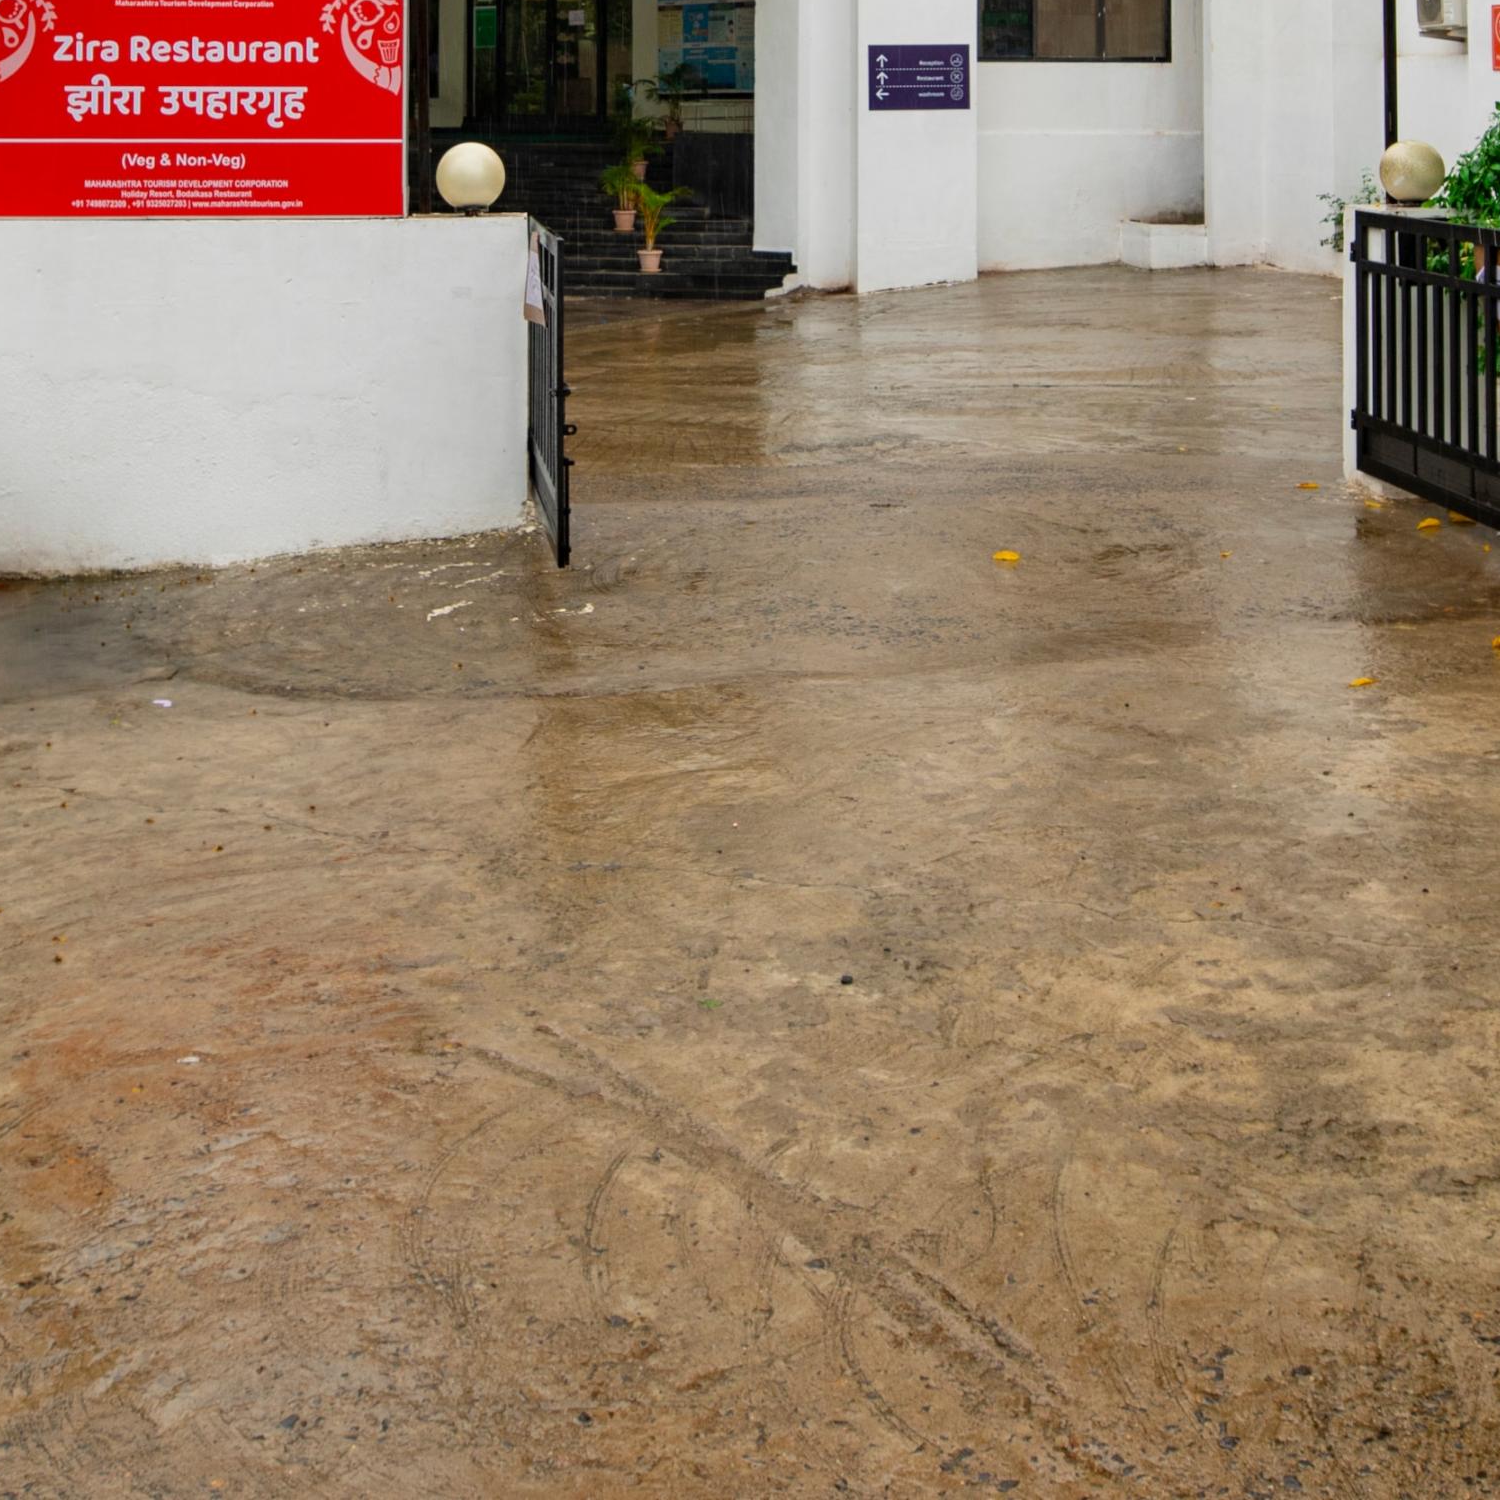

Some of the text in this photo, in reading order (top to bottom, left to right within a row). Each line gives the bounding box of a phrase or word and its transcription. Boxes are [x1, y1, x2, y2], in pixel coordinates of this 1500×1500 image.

[115, 0, 275, 9] Maharashtra Tourism Development Corporation
[53, 32, 320, 64] Zira Restaurant
[64, 74, 308, 128] झीरा उपहारगृह
[121, 152, 246, 170] (Veg & Non-Veg)
[84, 179, 289, 188] MAHARASHTRA TOURISM DEVELOPMENT CORPORATION
[121, 190, 148, 199] Holiday
[176, 190, 213, 198] Bodalkasa
[214, 190, 252, 198] Restaurant
[71, 200, 84, 208] +91
[132, 200, 145, 208] +91
[192, 199, 303, 209] www.maharashtratourism.gov.in
